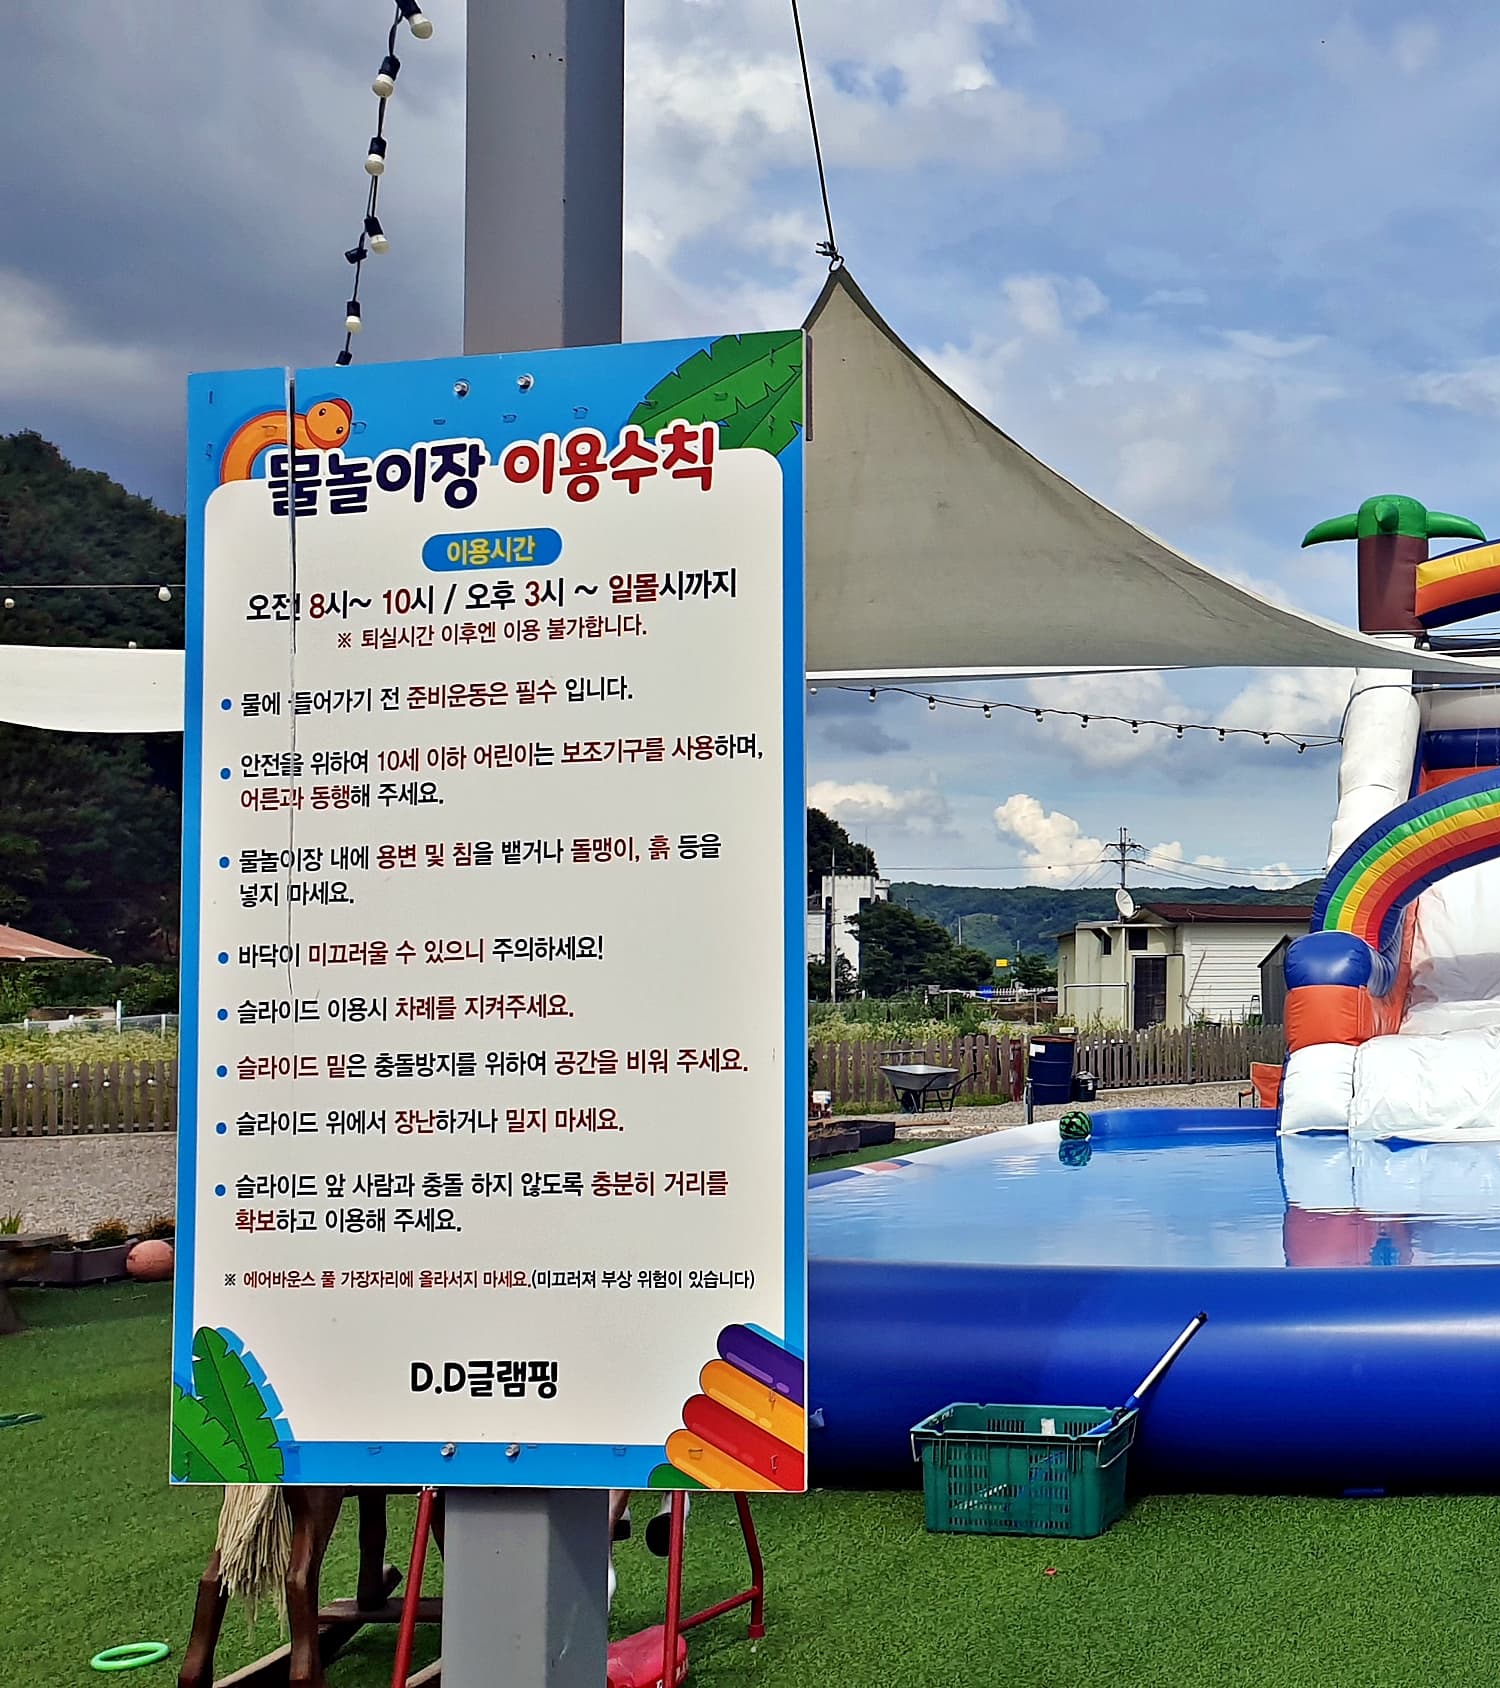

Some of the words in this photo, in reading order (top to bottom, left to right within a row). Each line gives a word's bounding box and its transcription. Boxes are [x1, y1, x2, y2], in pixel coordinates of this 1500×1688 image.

[268, 444, 486, 517] 물놀이장
[503, 424, 715, 502] 이용수칙
[446, 536, 537, 565] 이용시간
[246, 591, 301, 622] 오전
[382, 585, 434, 615] 10시
[465, 580, 516, 611] 오후
[524, 577, 564, 607] 3시
[608, 567, 736, 604] 일몰시까지
[360, 624, 435, 650] 퇴실시간
[441, 621, 496, 646] 이후엔
[503, 619, 541, 643] 이용
[546, 613, 647, 640] 불가합니다.
[240, 691, 281, 717] 물에
[288, 687, 372, 716] 들어가기
[379, 686, 400, 711] 전
[406, 681, 509, 710] 준비운동은
[515, 679, 558, 705] 필수
[565, 675, 633, 703] 입니다.
[241, 752, 305, 778] 안전을
[310, 749, 369, 776] 위하여
[377, 747, 419, 772] 10세
[427, 745, 468, 771] 이하
[473, 742, 555, 769] 어린이는
[560, 737, 666, 764] 보조기구를
[671, 733, 763, 761] 사용하며,
[240, 786, 305, 812] 어른과
[310, 783, 370, 810] 동행해
[377, 781, 444, 808] 주세요.
[238, 845, 324, 874] 물놀이장
[330, 845, 369, 871] 내에
[376, 843, 417, 870] 용변
[425, 842, 445, 868] 및
[452, 841, 494, 867] 침을
[501, 838, 565, 865] 뱉거나
[570, 836, 640, 863] 돌맹이,
[647, 834, 671, 861] 흙
[677, 833, 722, 860] 등을
[239, 882, 279, 908] 넣지
[287, 880, 355, 908] 마세요.
[238, 942, 300, 969] 바닥이
[308, 940, 389, 967] 미끄러울
[395, 940, 417, 965] 수
[424, 938, 484, 964] 있으니
[492, 935, 603, 963] 주의하세요!
[237, 998, 321, 1025] 슬라이드
[327, 996, 387, 1023] 이용시
[394, 995, 457, 1021] 차례를
[464, 993, 574, 1020] 지켜주세요.
[236, 1054, 319, 1080] 슬라이드
[327, 1053, 368, 1079] 밑은
[373, 1052, 478, 1078] 충돌방지를
[484, 1050, 546, 1077] 위하여
[554, 1049, 619, 1076] 공간을
[627, 1048, 668, 1075] 비워
[676, 1047, 749, 1074] 주세요.
[235, 1110, 319, 1137] 슬라이드
[325, 1109, 386, 1136] 위에서
[394, 1108, 499, 1135] 장난하거나
[505, 1107, 547, 1133] 밀지
[555, 1107, 624, 1133] 마세요.
[235, 1173, 318, 1199] 슬라이드
[325, 1173, 347, 1198] 앞
[351, 1172, 416, 1198] 사람과
[421, 1172, 464, 1198] 충돌
[470, 1171, 513, 1198] 하지
[520, 1171, 584, 1198] 않도록
[590, 1171, 655, 1197] 충분히
[664, 1170, 729, 1197] 거리를
[234, 1208, 318, 1234] 확보하고
[325, 1207, 386, 1233] 이용해
[393, 1207, 462, 1233] 주세요.
[243, 1270, 317, 1289] 에어바운스
[320, 1270, 336, 1289] 풀
[340, 1270, 414, 1289] 가장자리에
[418, 1270, 478, 1289] 올라서지
[600, 1270, 633, 1289] 부상
[637, 1269, 682, 1289] 위험이
[688, 1269, 755, 1290] 있습니다)
[411, 1360, 558, 1399] D.D글램핑
